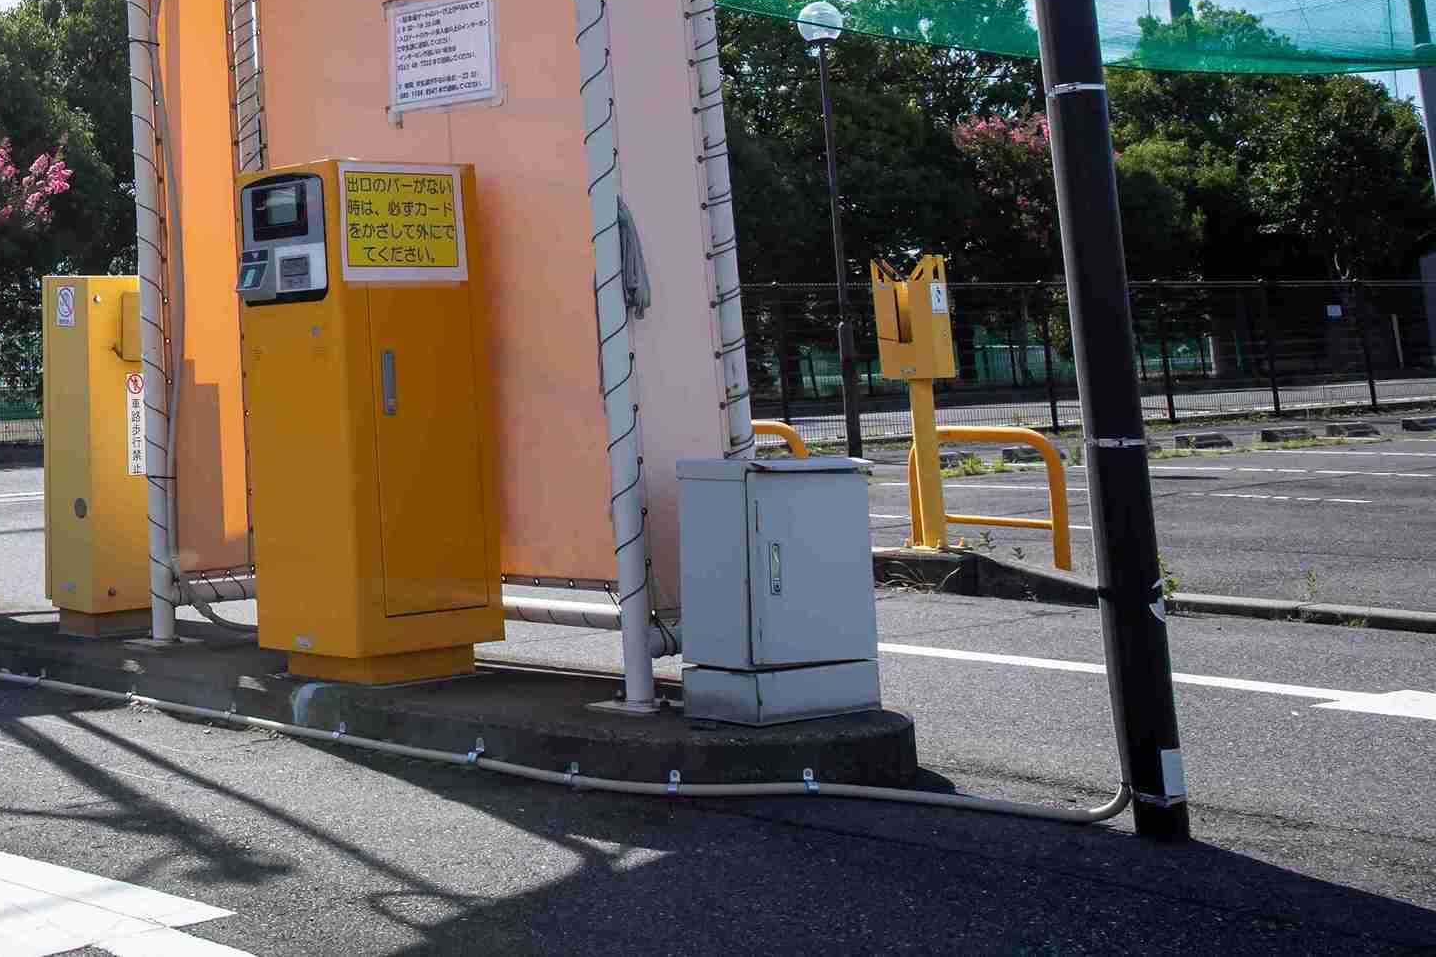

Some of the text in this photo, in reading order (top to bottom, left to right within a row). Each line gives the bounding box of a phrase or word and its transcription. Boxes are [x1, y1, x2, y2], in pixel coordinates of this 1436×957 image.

[347, 177, 452, 195] 出口のバーがない
[347, 201, 453, 218] 時は、必ずカード
